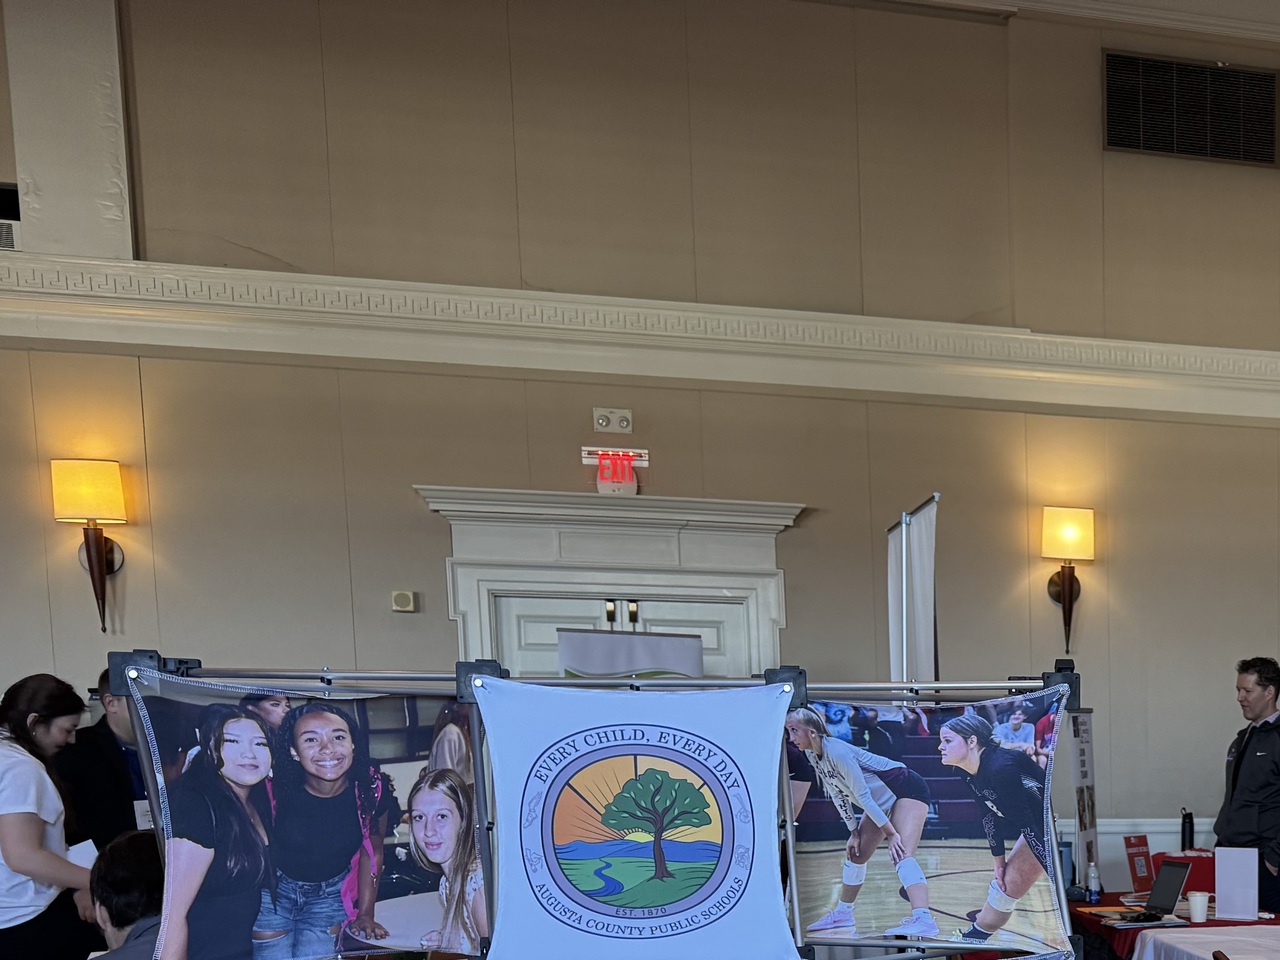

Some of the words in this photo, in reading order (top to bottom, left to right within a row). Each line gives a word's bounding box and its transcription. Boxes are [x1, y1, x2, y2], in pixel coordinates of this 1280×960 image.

[598, 455, 634, 482] EXIT
[534, 739, 581, 784] EVERY
[583, 728, 650, 747] CHILD,
[657, 731, 717, 765] EVERY
[712, 758, 742, 791] DAY
[535, 881, 582, 926] AUGUSTA
[586, 917, 646, 936] COUNTY
[649, 914, 701, 936] PUBLIC
[701, 876, 744, 921] SCHOOLS
[615, 907, 637, 917] EST.
[641, 906, 667, 917] 1870
